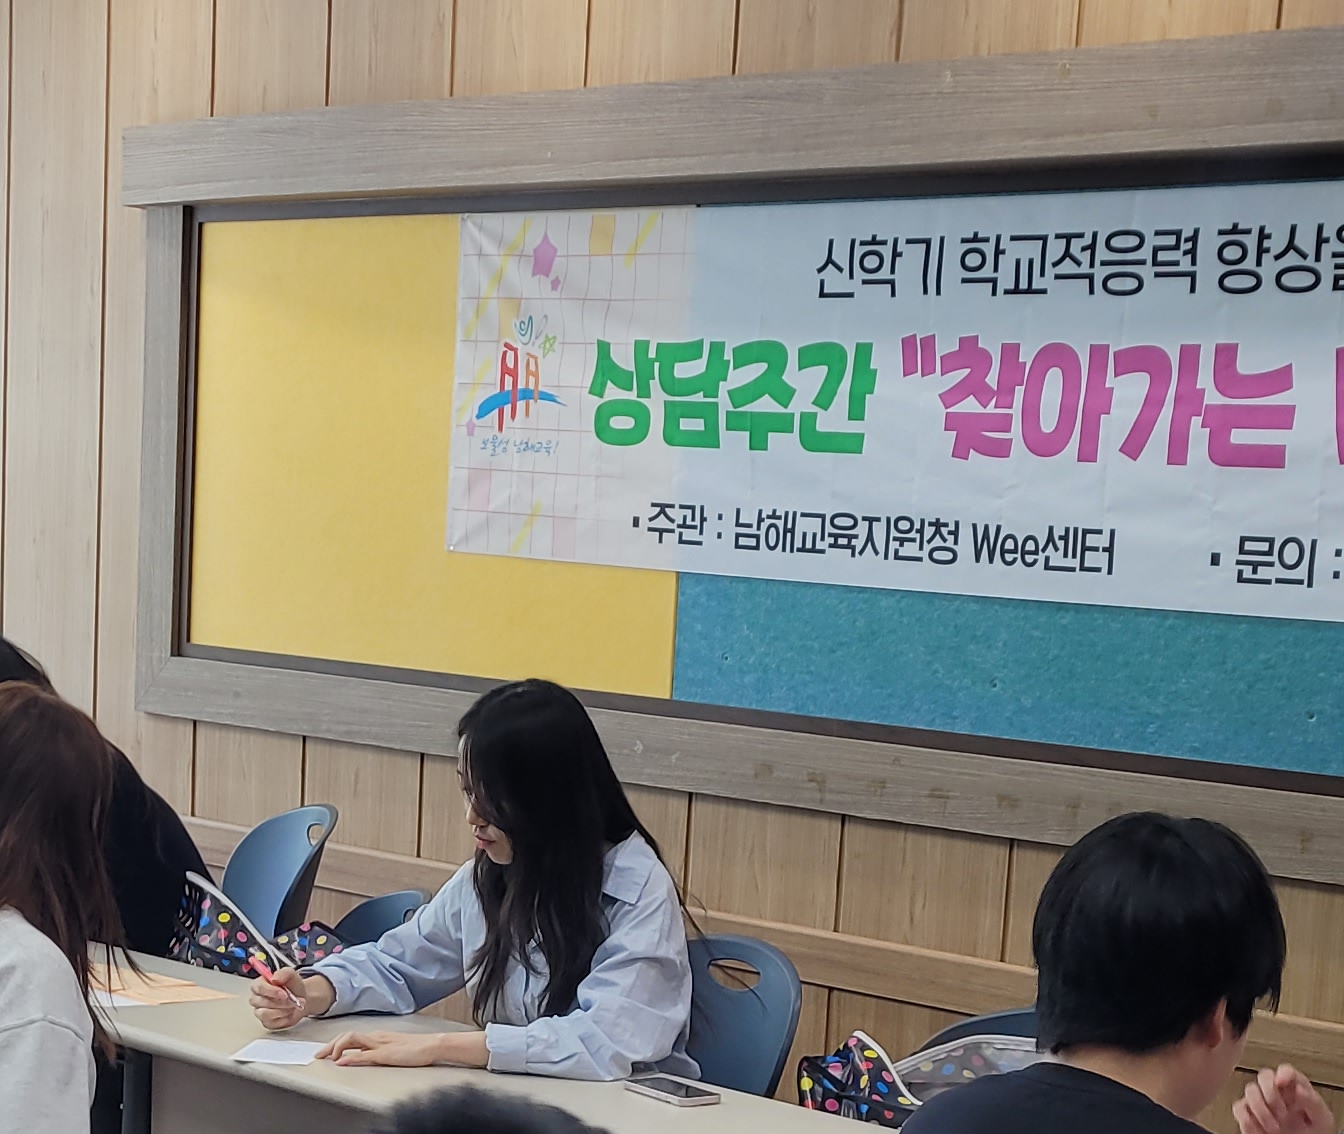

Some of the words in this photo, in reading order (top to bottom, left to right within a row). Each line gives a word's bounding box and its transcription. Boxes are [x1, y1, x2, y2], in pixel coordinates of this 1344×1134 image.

[815, 233, 946, 300] 신학기
[959, 226, 1201, 298] 학교적응력
[588, 337, 878, 455] 상담주간
[646, 501, 707, 547] 주관
[733, 507, 960, 566] 남해교육지원청
[971, 521, 1117, 576] Wee센터
[1235, 535, 1319, 589] 문의
